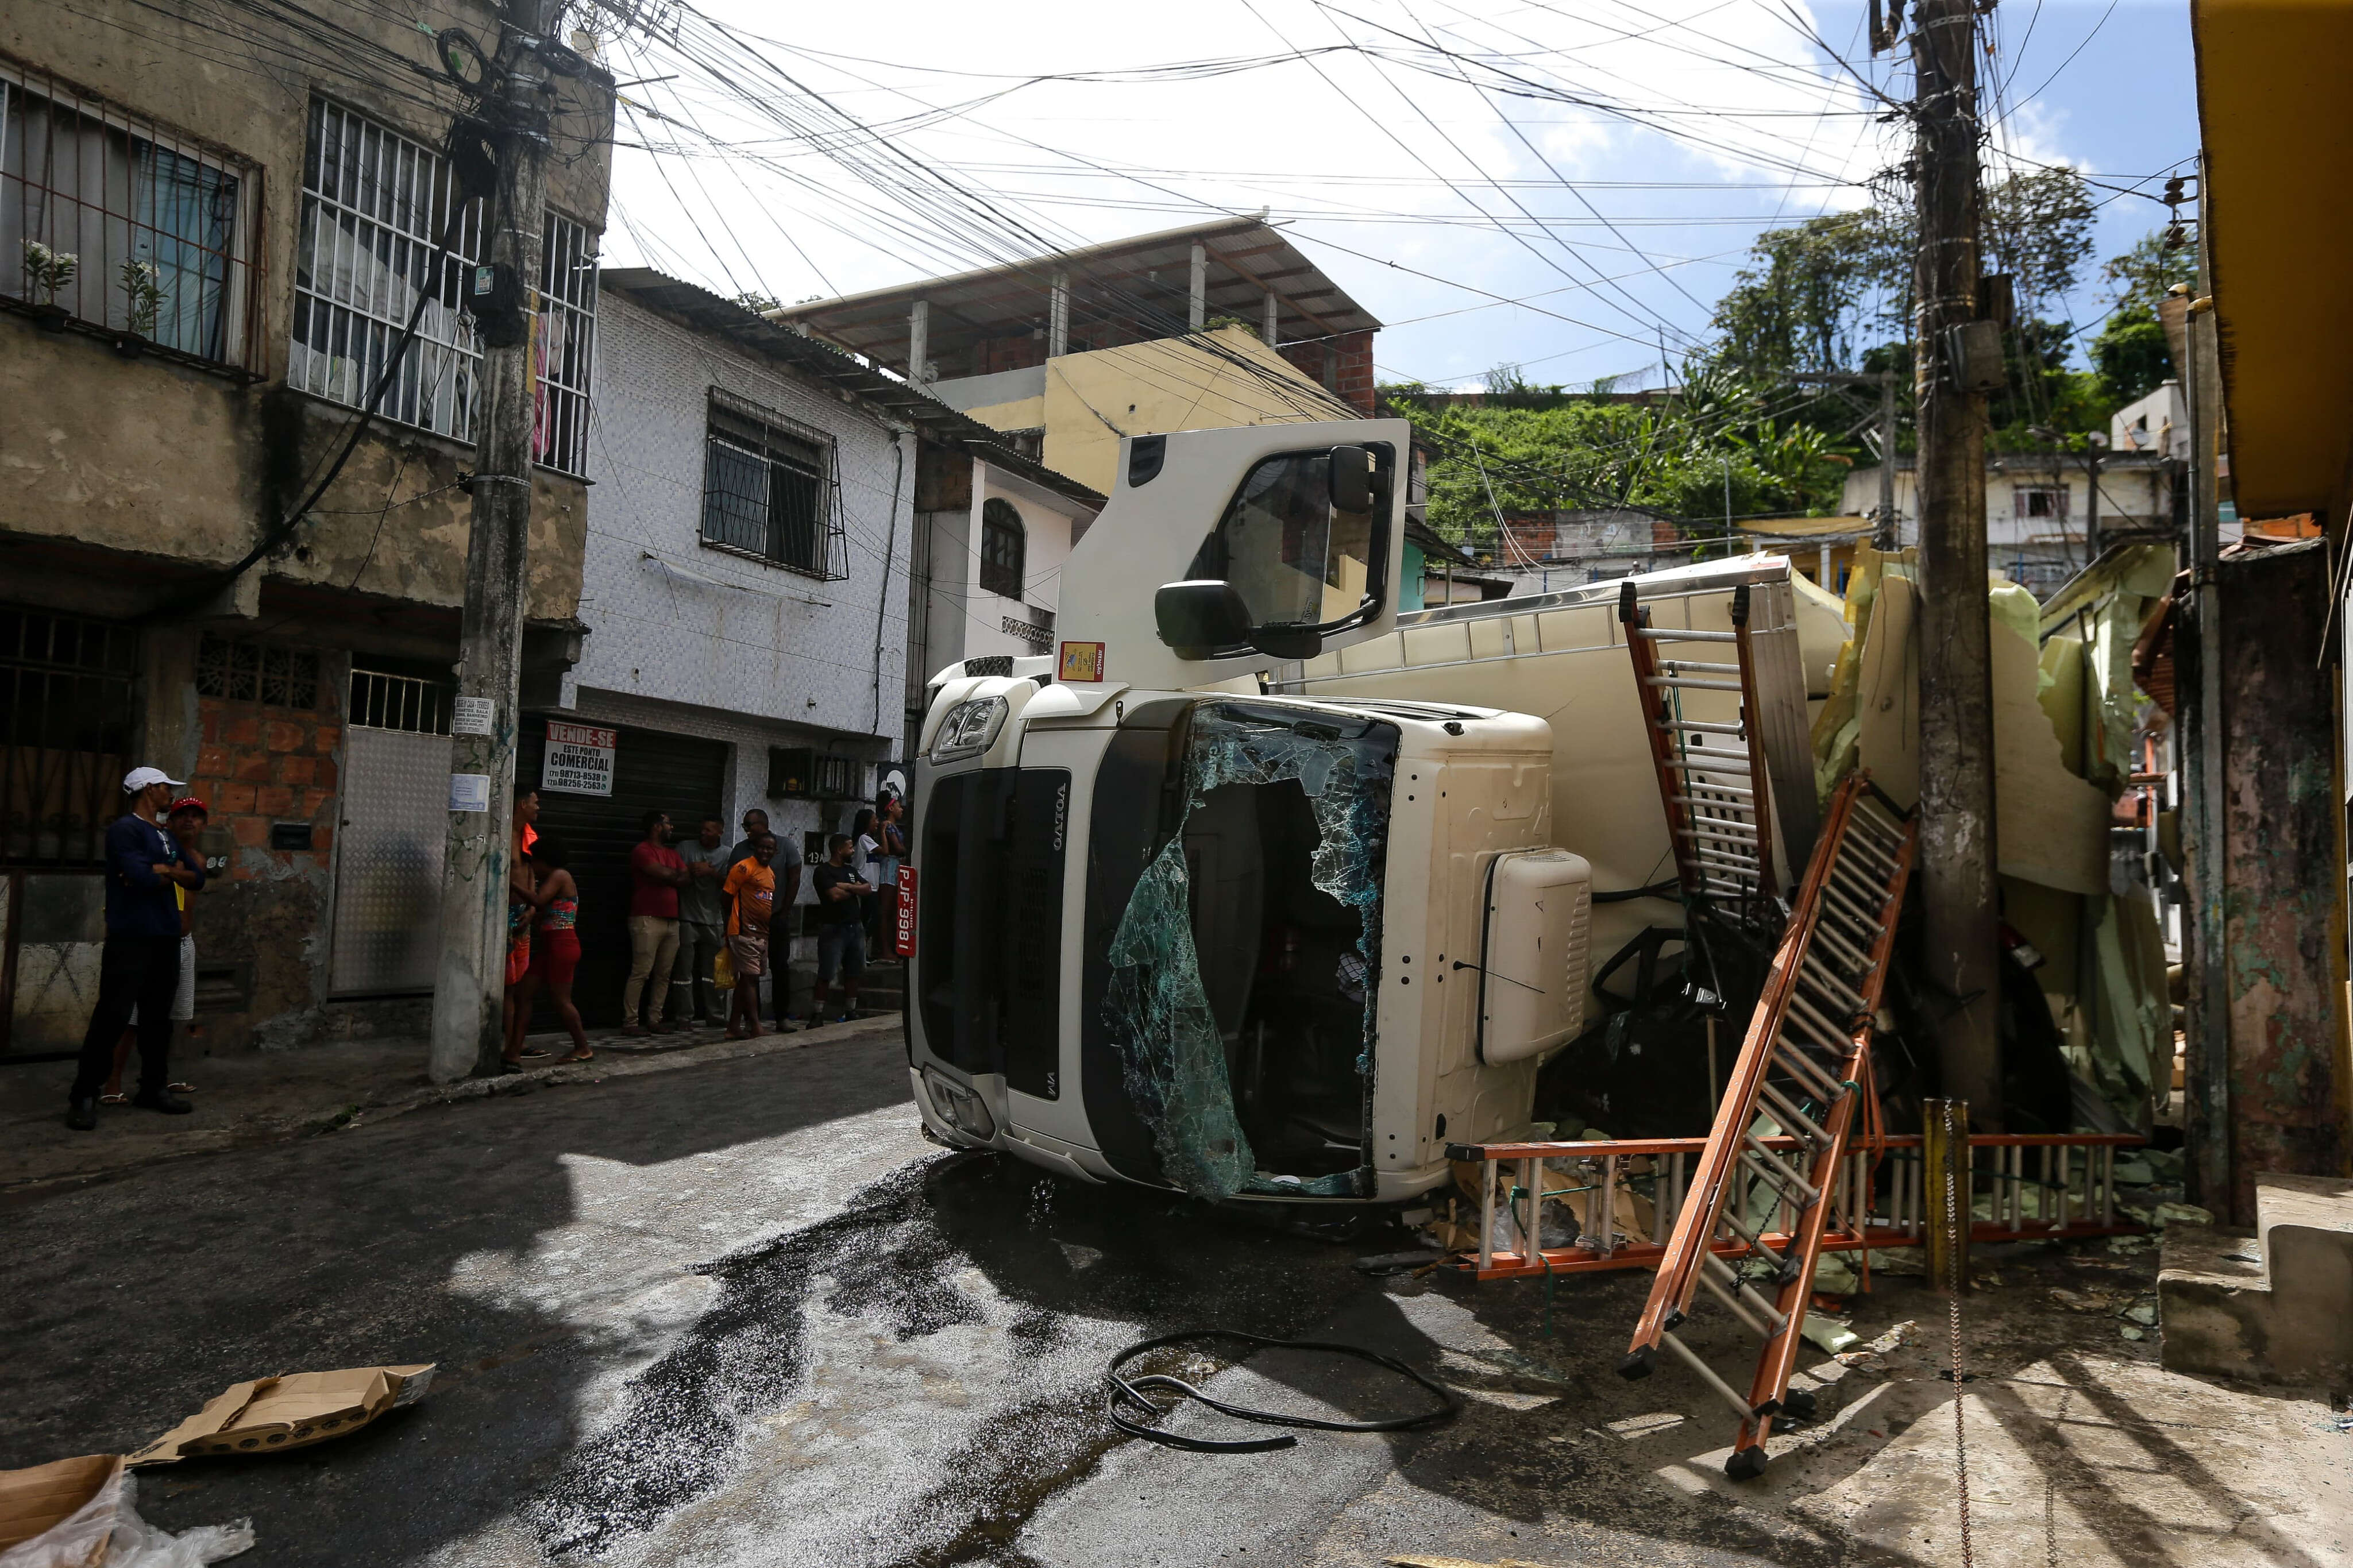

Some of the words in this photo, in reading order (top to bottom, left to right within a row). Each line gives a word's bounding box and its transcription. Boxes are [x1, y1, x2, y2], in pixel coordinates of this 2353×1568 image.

[549, 724, 614, 747] VENDE-SE
[564, 745, 579, 754] ESTE
[580, 747, 600, 757] PONTO
[551, 752, 609, 771] COMERCIAL
[560, 770, 601, 782] 98713-8538
[558, 778, 601, 790] 98256-2563
[1054, 783, 1066, 851] VOLVO
